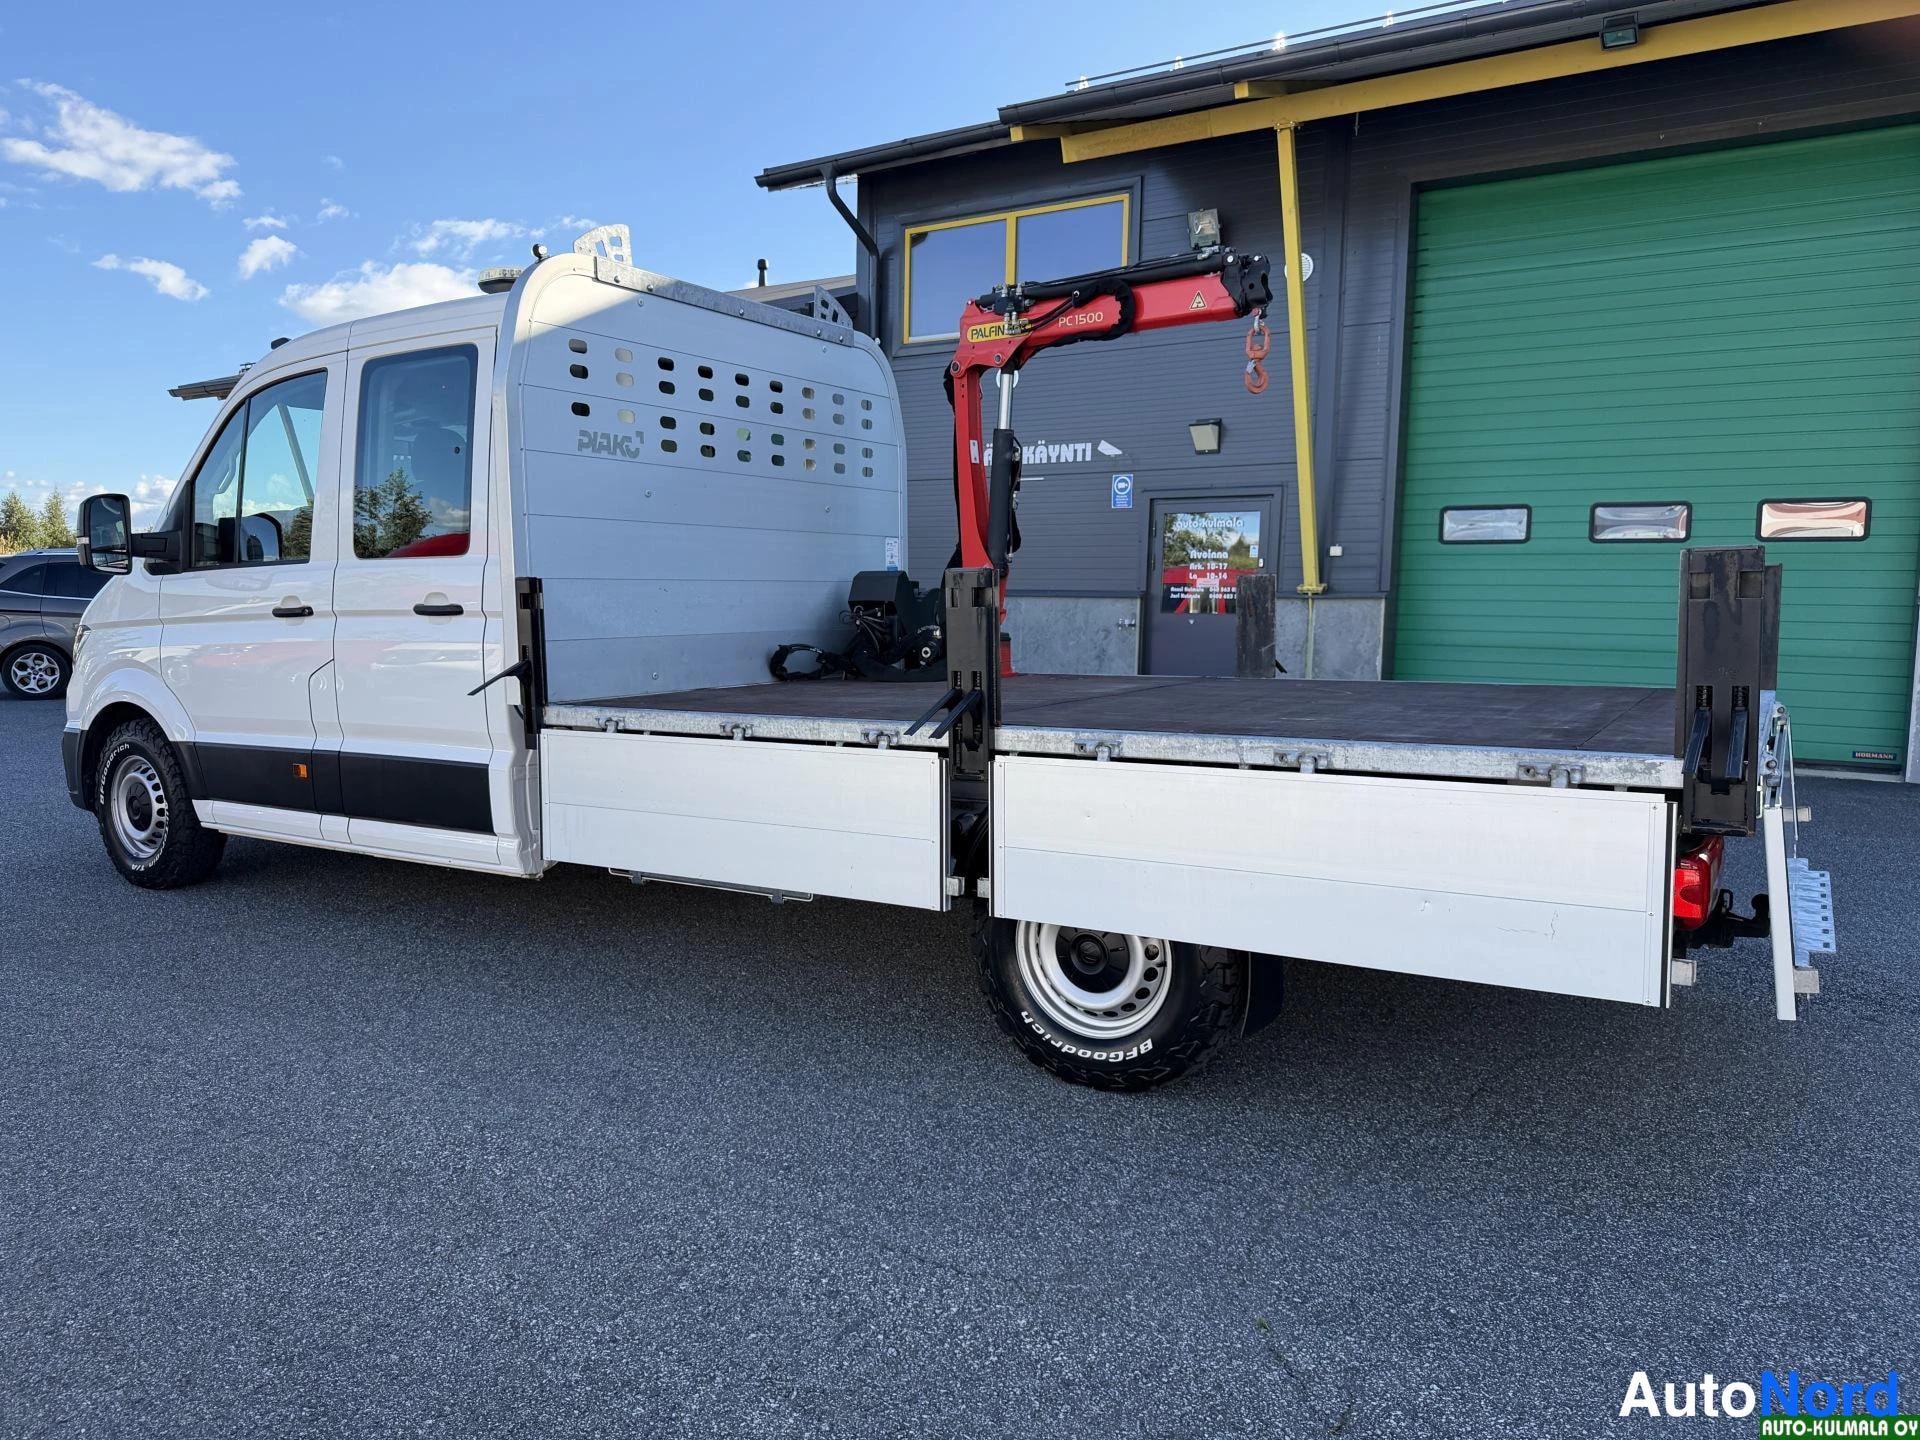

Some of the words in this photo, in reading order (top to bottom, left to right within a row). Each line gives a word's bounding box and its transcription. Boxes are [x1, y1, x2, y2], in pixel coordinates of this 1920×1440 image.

[1058, 316, 1073, 328] PC
[1075, 312, 1104, 325] 1500
[971, 322, 1027, 340] PALFIN
[1189, 549, 1229, 559] Avoinna
[1020, 1010, 1153, 1063] BFGoodrich
